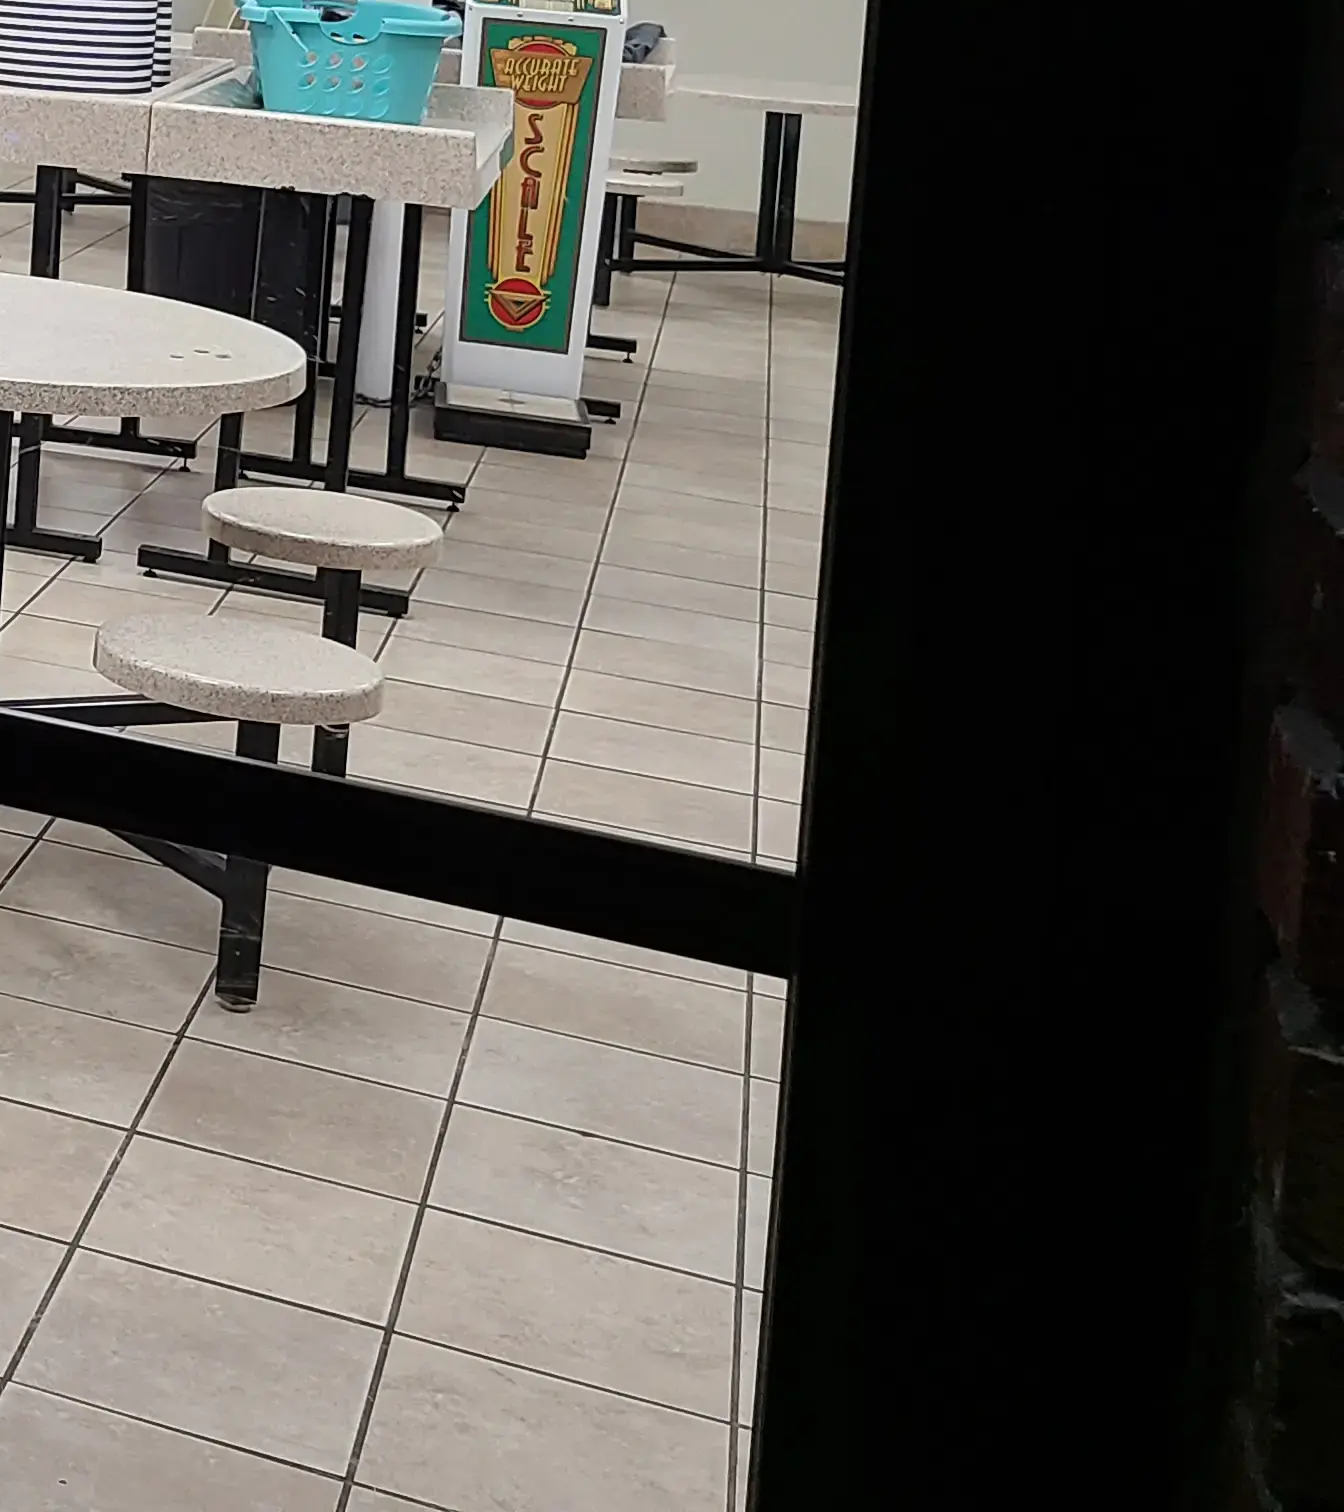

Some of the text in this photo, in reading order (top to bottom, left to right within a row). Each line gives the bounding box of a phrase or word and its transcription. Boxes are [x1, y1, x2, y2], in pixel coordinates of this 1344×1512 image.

[504, 58, 579, 77] ACCURATE
[511, 74, 568, 93] WEIGHT
[515, 113, 545, 273] SCALE
